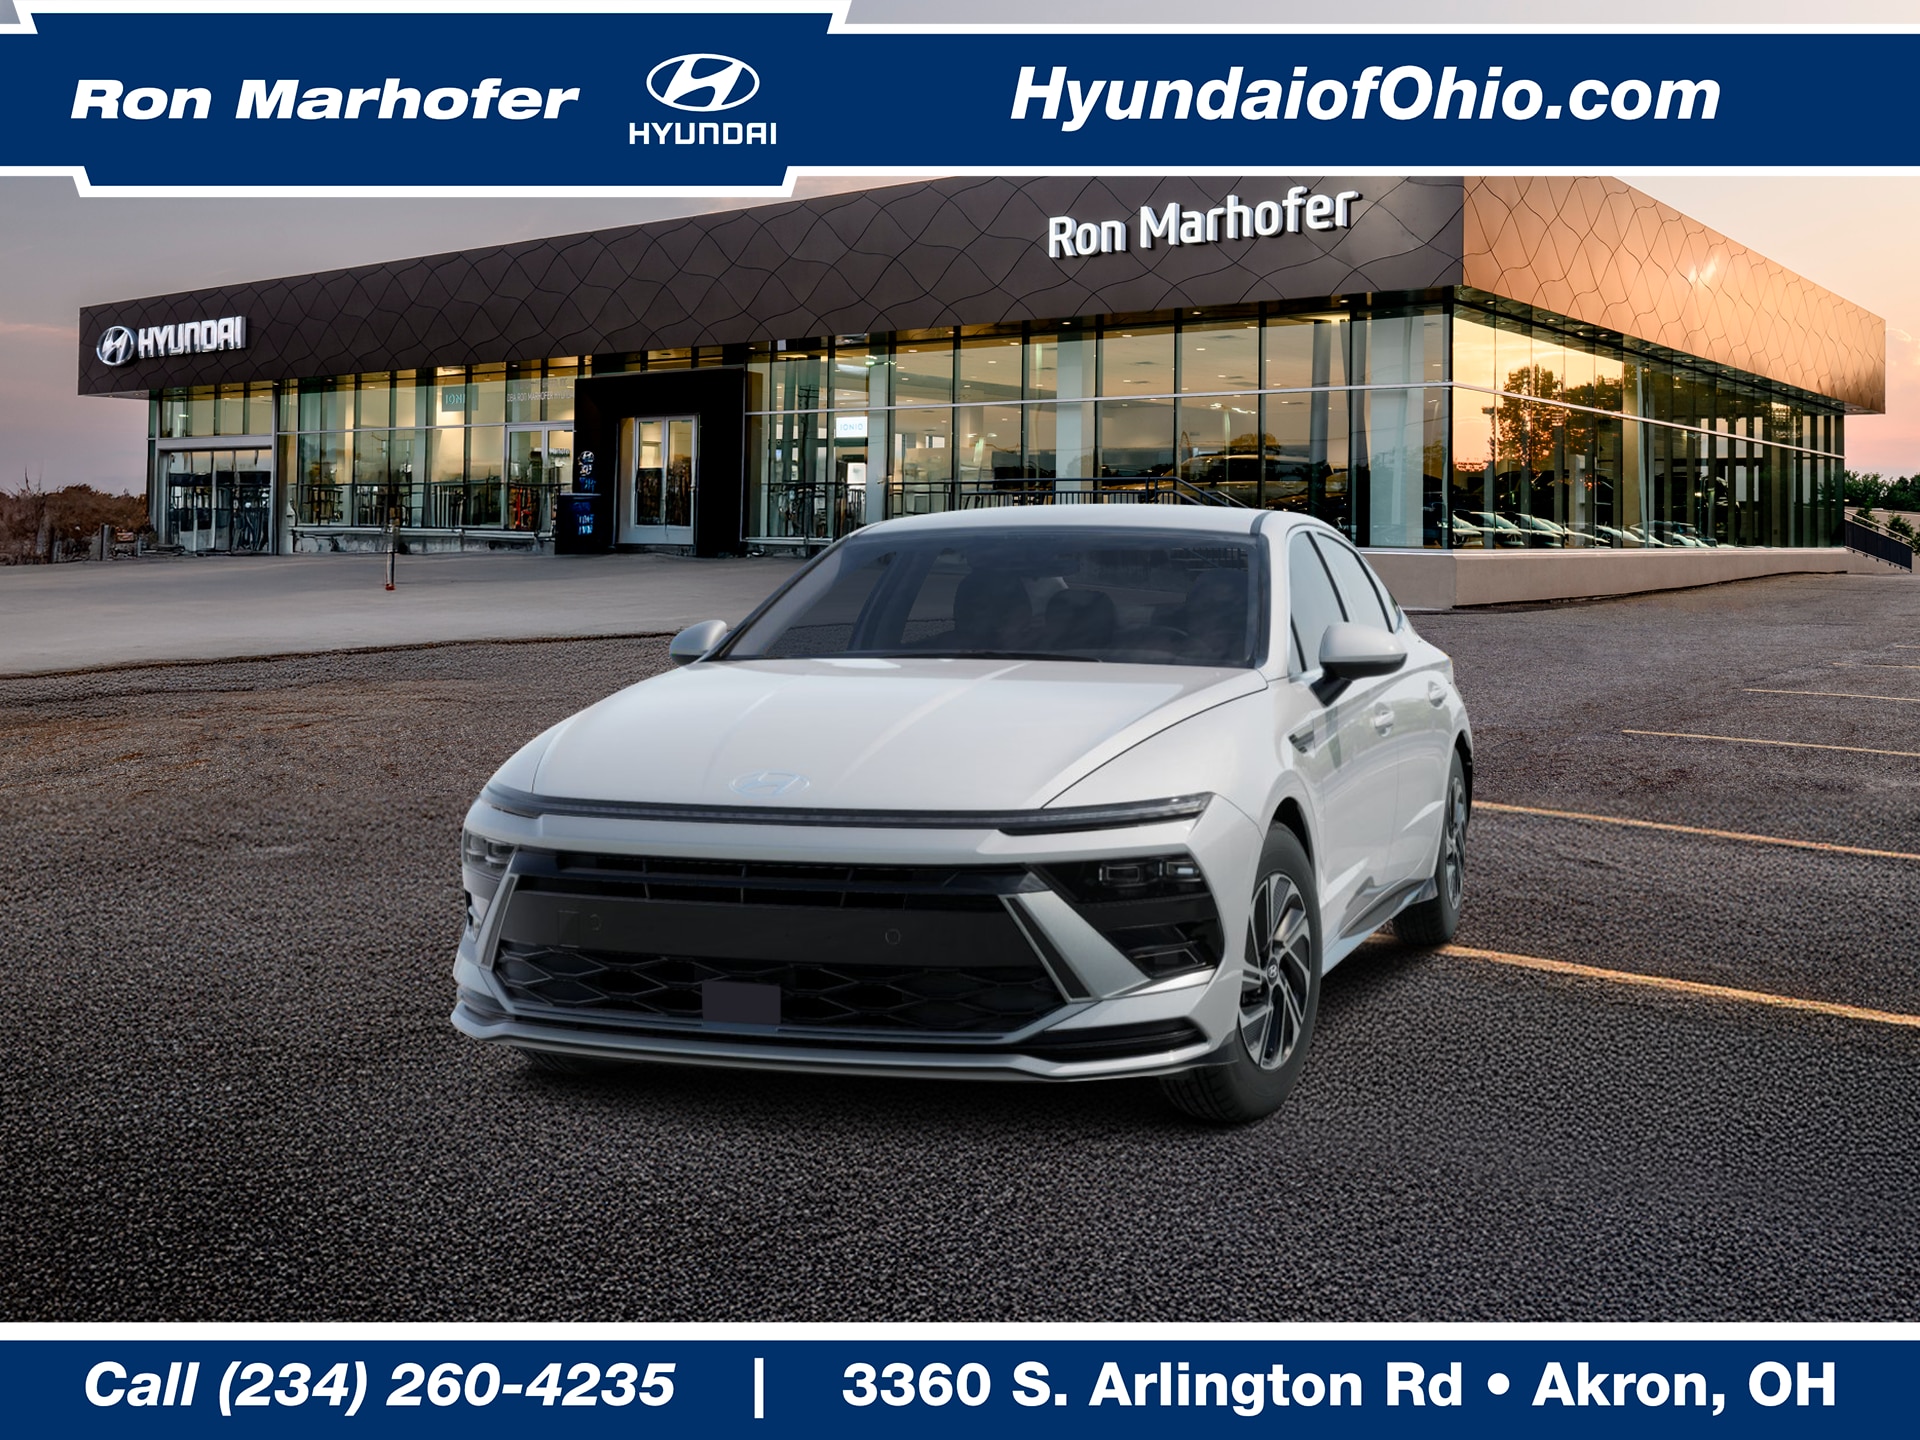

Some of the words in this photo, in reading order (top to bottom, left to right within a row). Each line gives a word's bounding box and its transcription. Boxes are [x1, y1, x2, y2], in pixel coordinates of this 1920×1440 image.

[1049, 216, 1127, 258] Ron
[1139, 186, 1360, 249] Marhofer
[138, 316, 246, 359] HYUNDAI
